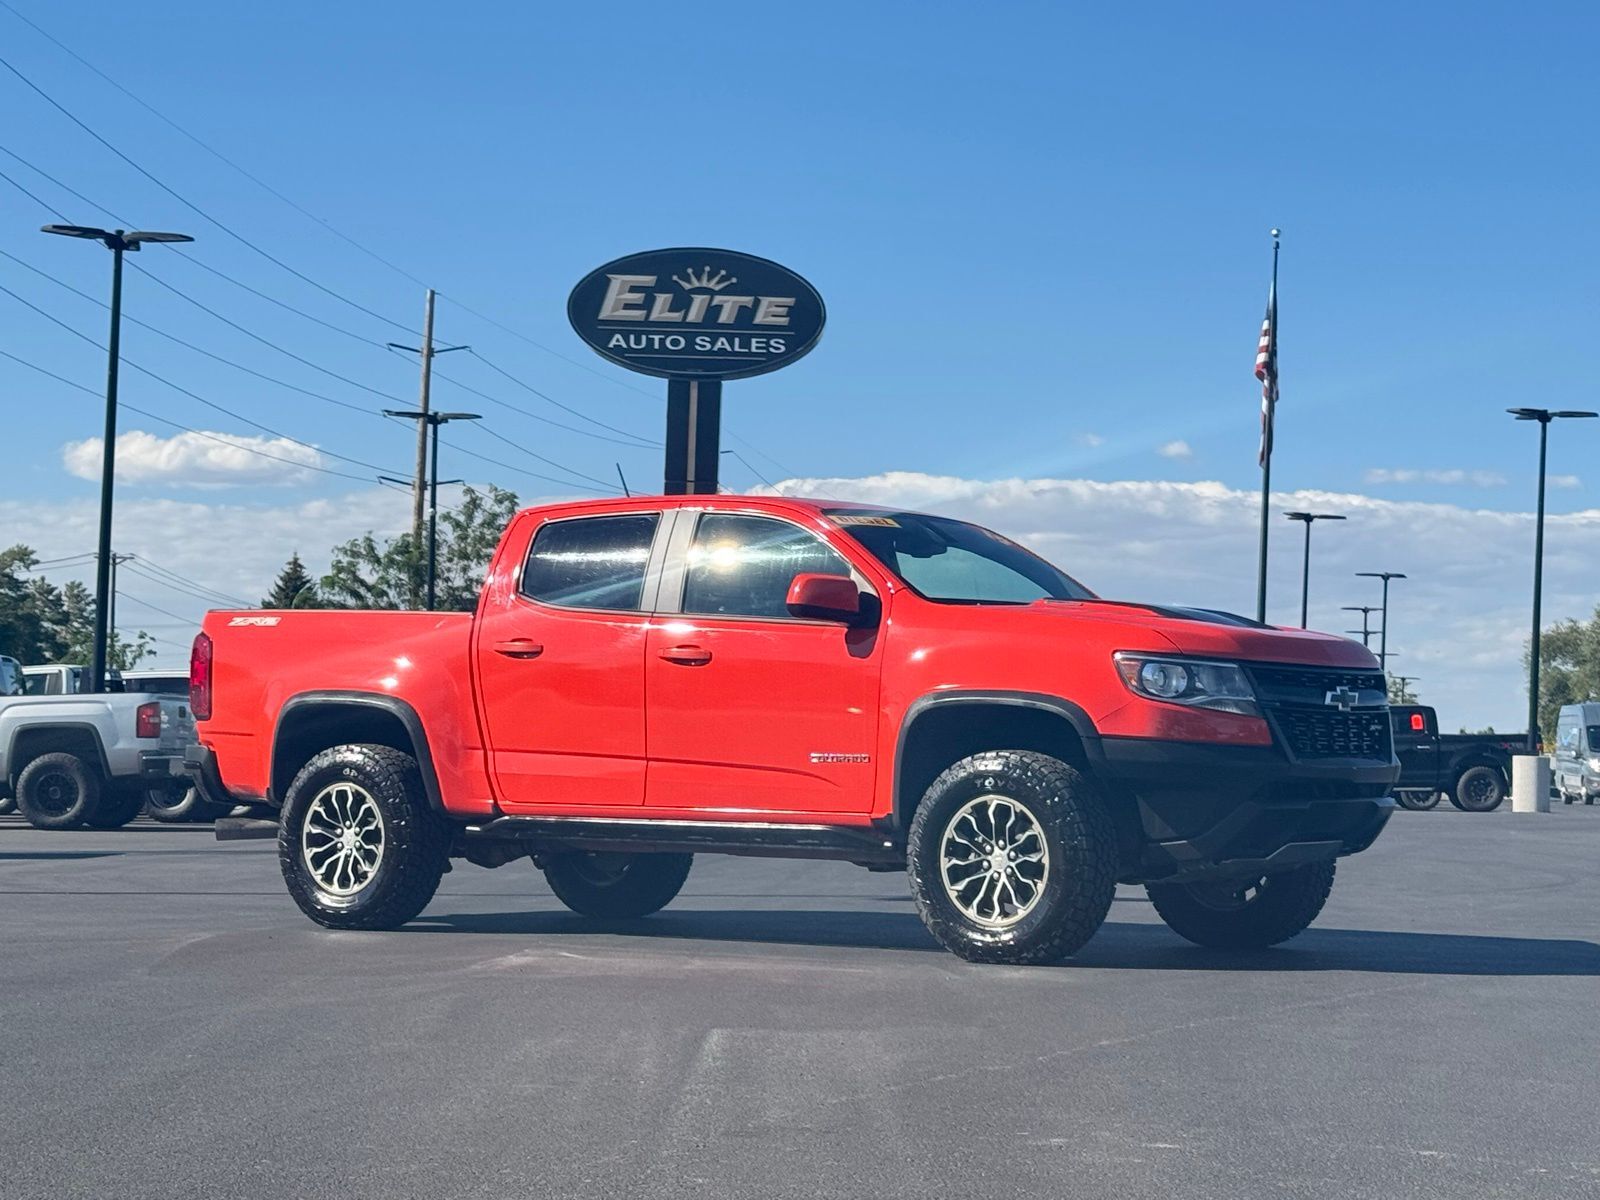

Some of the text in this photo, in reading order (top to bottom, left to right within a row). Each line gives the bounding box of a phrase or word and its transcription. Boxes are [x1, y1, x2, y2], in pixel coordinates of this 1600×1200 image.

[597, 273, 796, 326] ELITE
[607, 333, 787, 354] AUTO SALES
